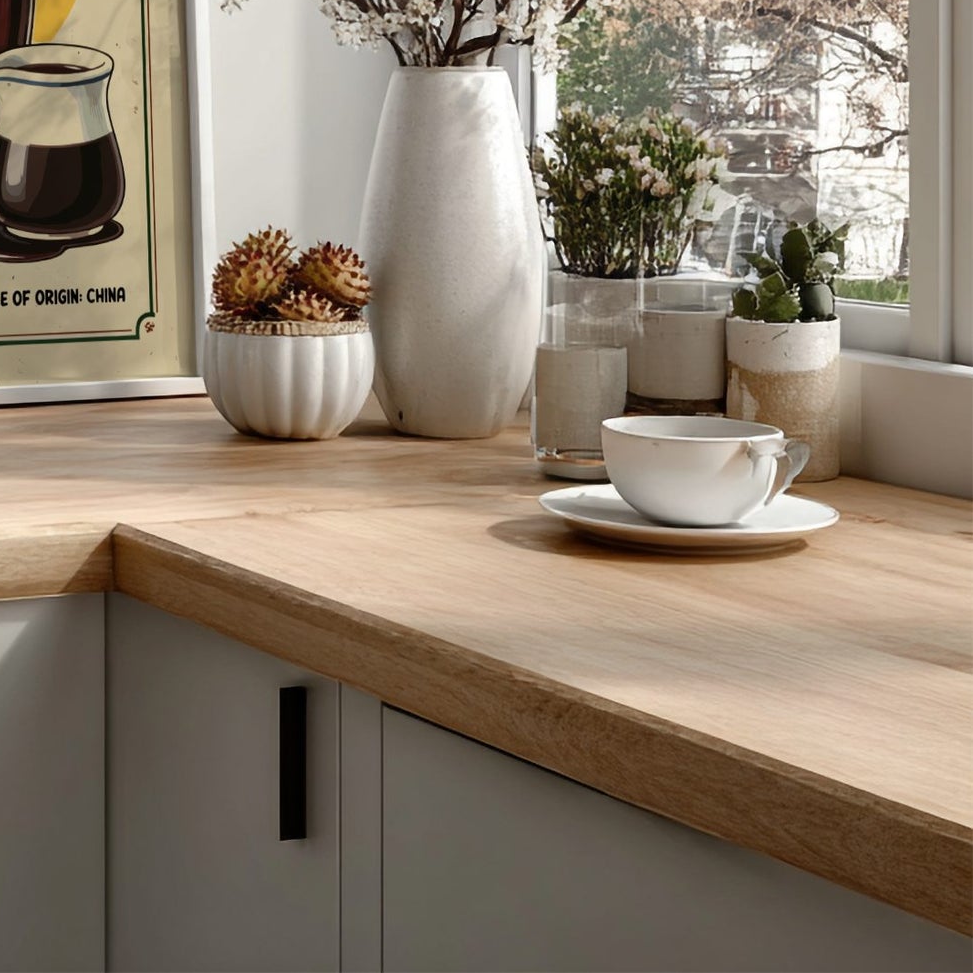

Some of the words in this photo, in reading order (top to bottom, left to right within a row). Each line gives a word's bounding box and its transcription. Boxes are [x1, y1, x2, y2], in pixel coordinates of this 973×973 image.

[12, 289, 31, 307] OF
[34, 288, 83, 306] ORIGIN:
[86, 286, 126, 304] CHINA
